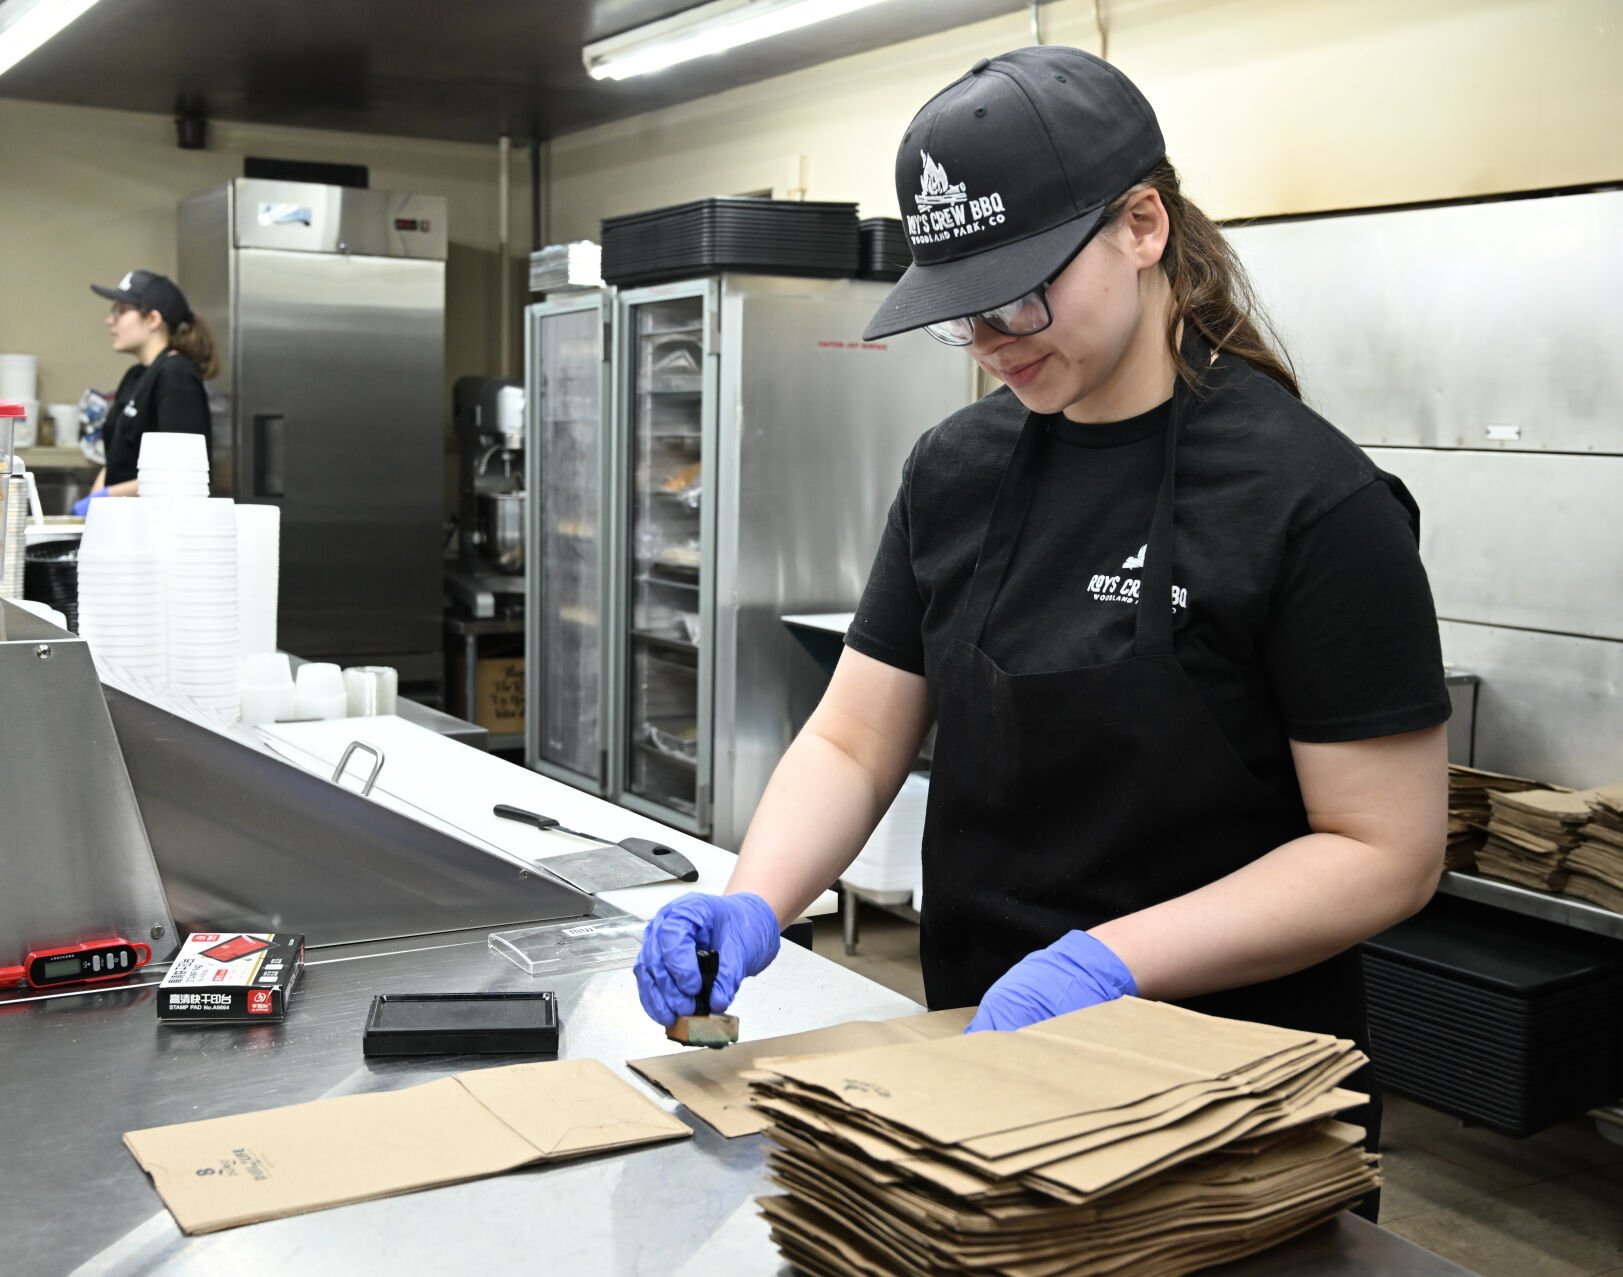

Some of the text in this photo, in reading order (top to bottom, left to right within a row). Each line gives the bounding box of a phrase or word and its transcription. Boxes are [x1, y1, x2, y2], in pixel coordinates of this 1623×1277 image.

[930, 204, 966, 231] CREW
[969, 193, 1005, 221] BBQ
[911, 213, 1006, 245] WOODLAND PARK, CO
[1120, 578, 1141, 598] CR
[1171, 584, 1188, 609] BQ
